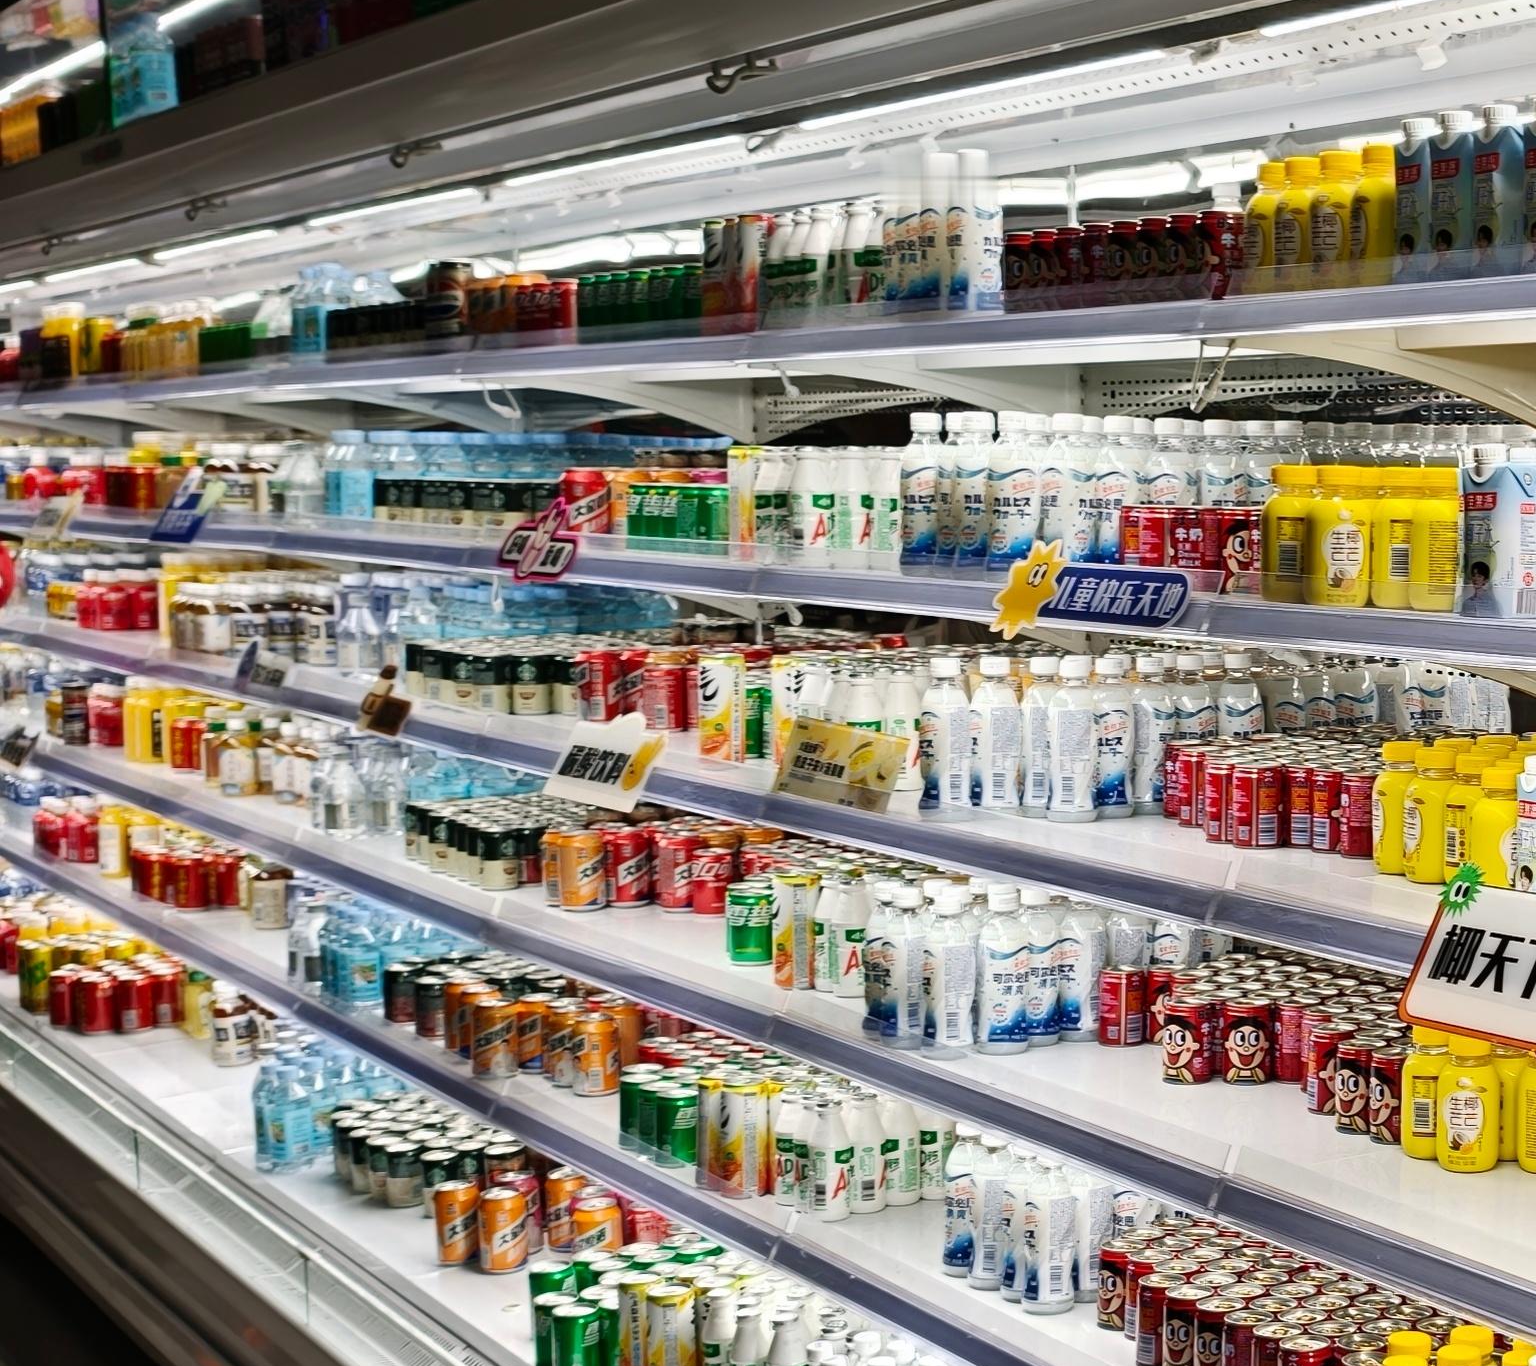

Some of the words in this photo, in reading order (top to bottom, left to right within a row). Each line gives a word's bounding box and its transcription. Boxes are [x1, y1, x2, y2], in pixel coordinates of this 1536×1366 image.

[1049, 575, 1186, 620] 儿童快乐天地
